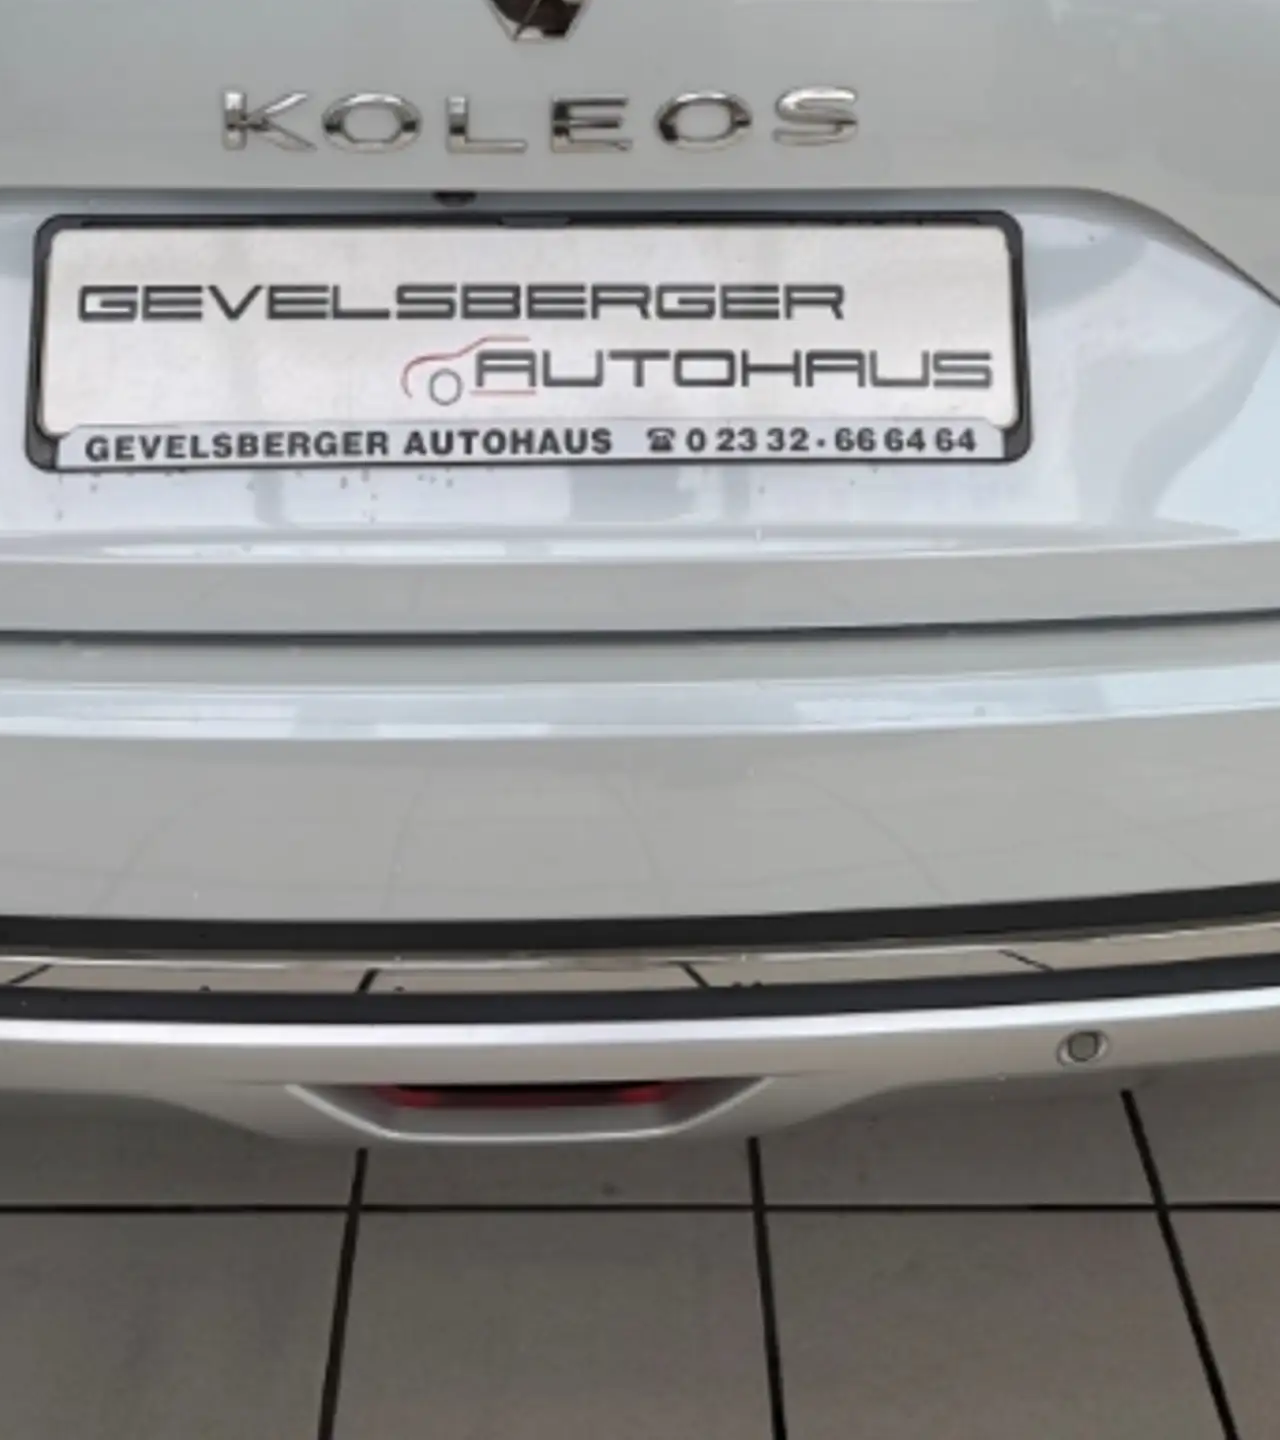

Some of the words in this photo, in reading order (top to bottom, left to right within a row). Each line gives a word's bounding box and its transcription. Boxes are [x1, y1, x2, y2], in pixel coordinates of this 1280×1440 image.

[222, 86, 859, 153] KOLEOS
[78, 284, 845, 322] GEVELSBERGER
[475, 349, 993, 389] AUTOHAUS
[85, 430, 390, 462] GEVELSBERGER
[403, 427, 613, 456] AUTOHAUS
